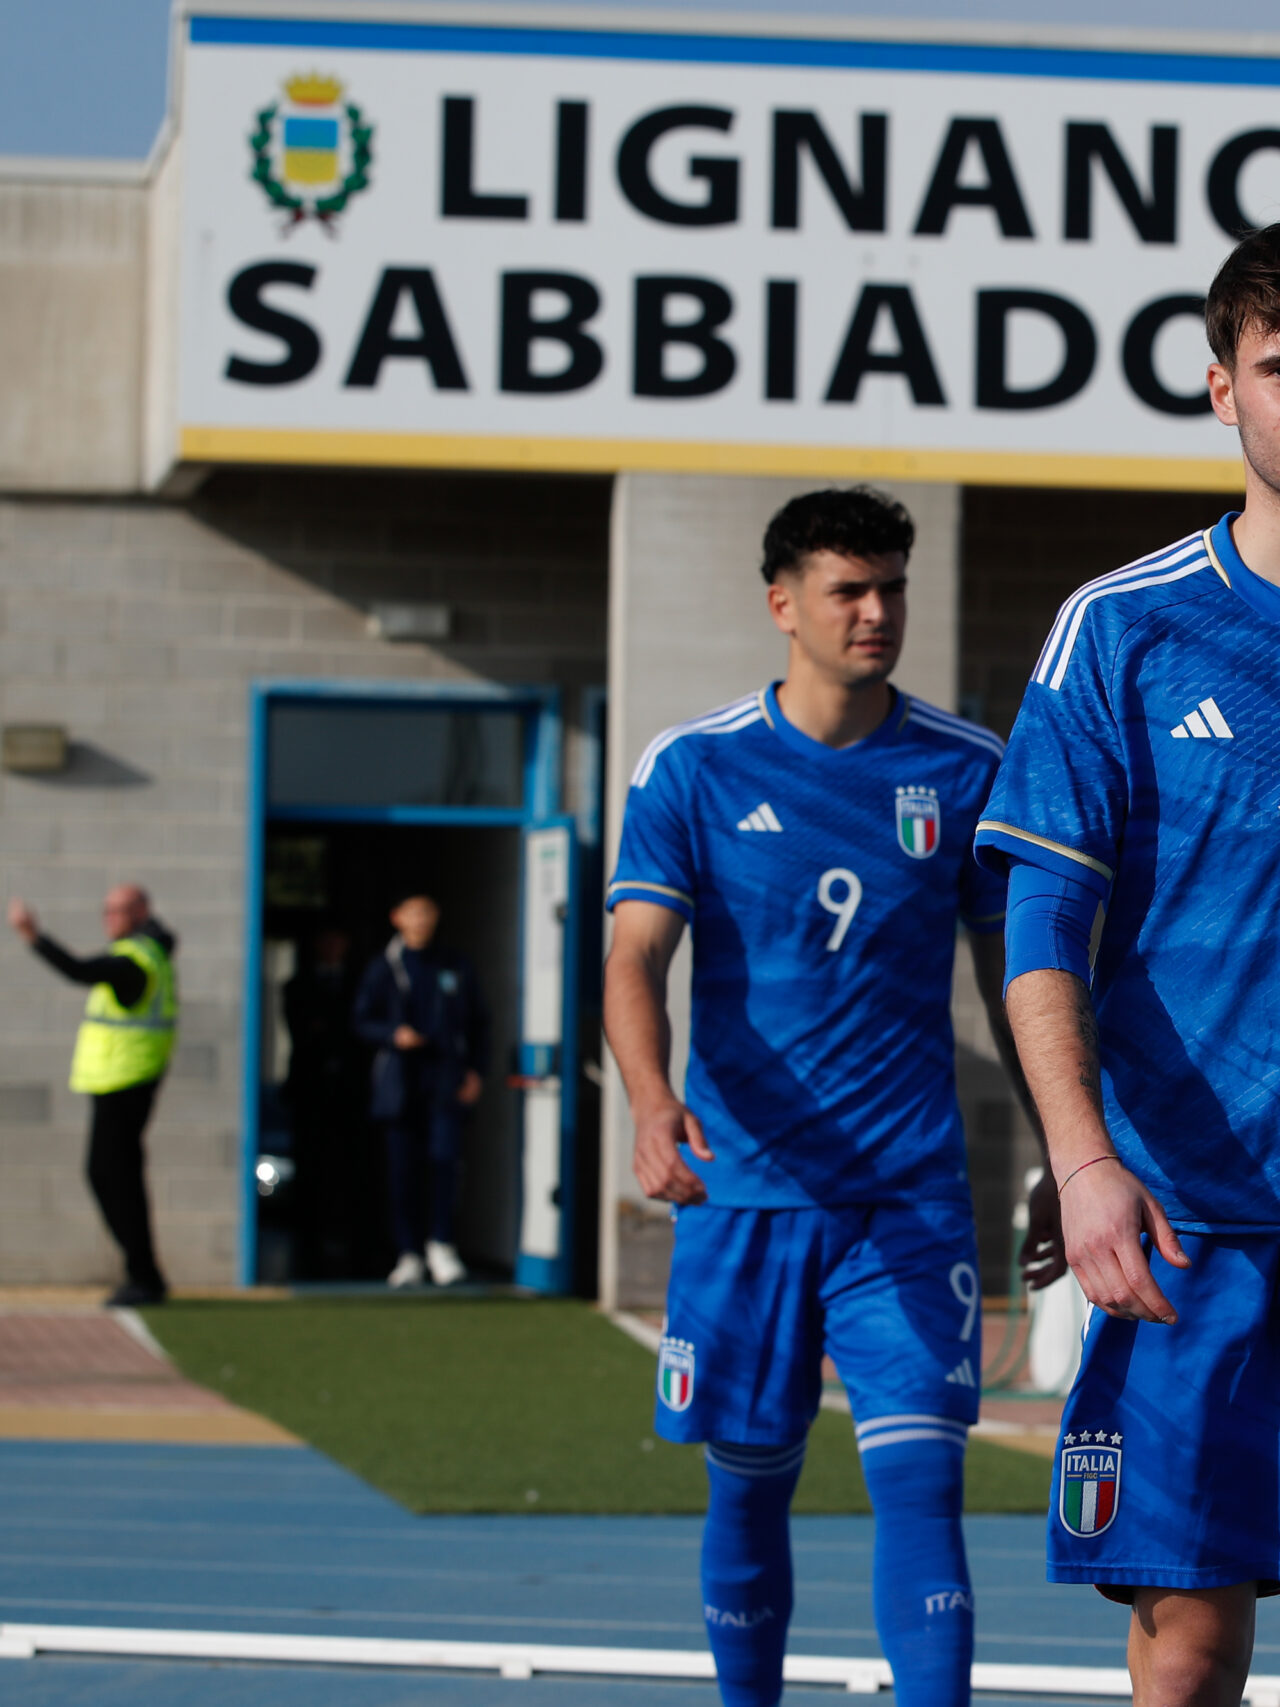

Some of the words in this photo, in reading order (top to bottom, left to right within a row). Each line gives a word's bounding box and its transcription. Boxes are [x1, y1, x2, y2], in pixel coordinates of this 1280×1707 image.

[817, 867, 863, 952] 9
[949, 1261, 978, 1341] 9
[1067, 1455, 1115, 1472] ITALIA
